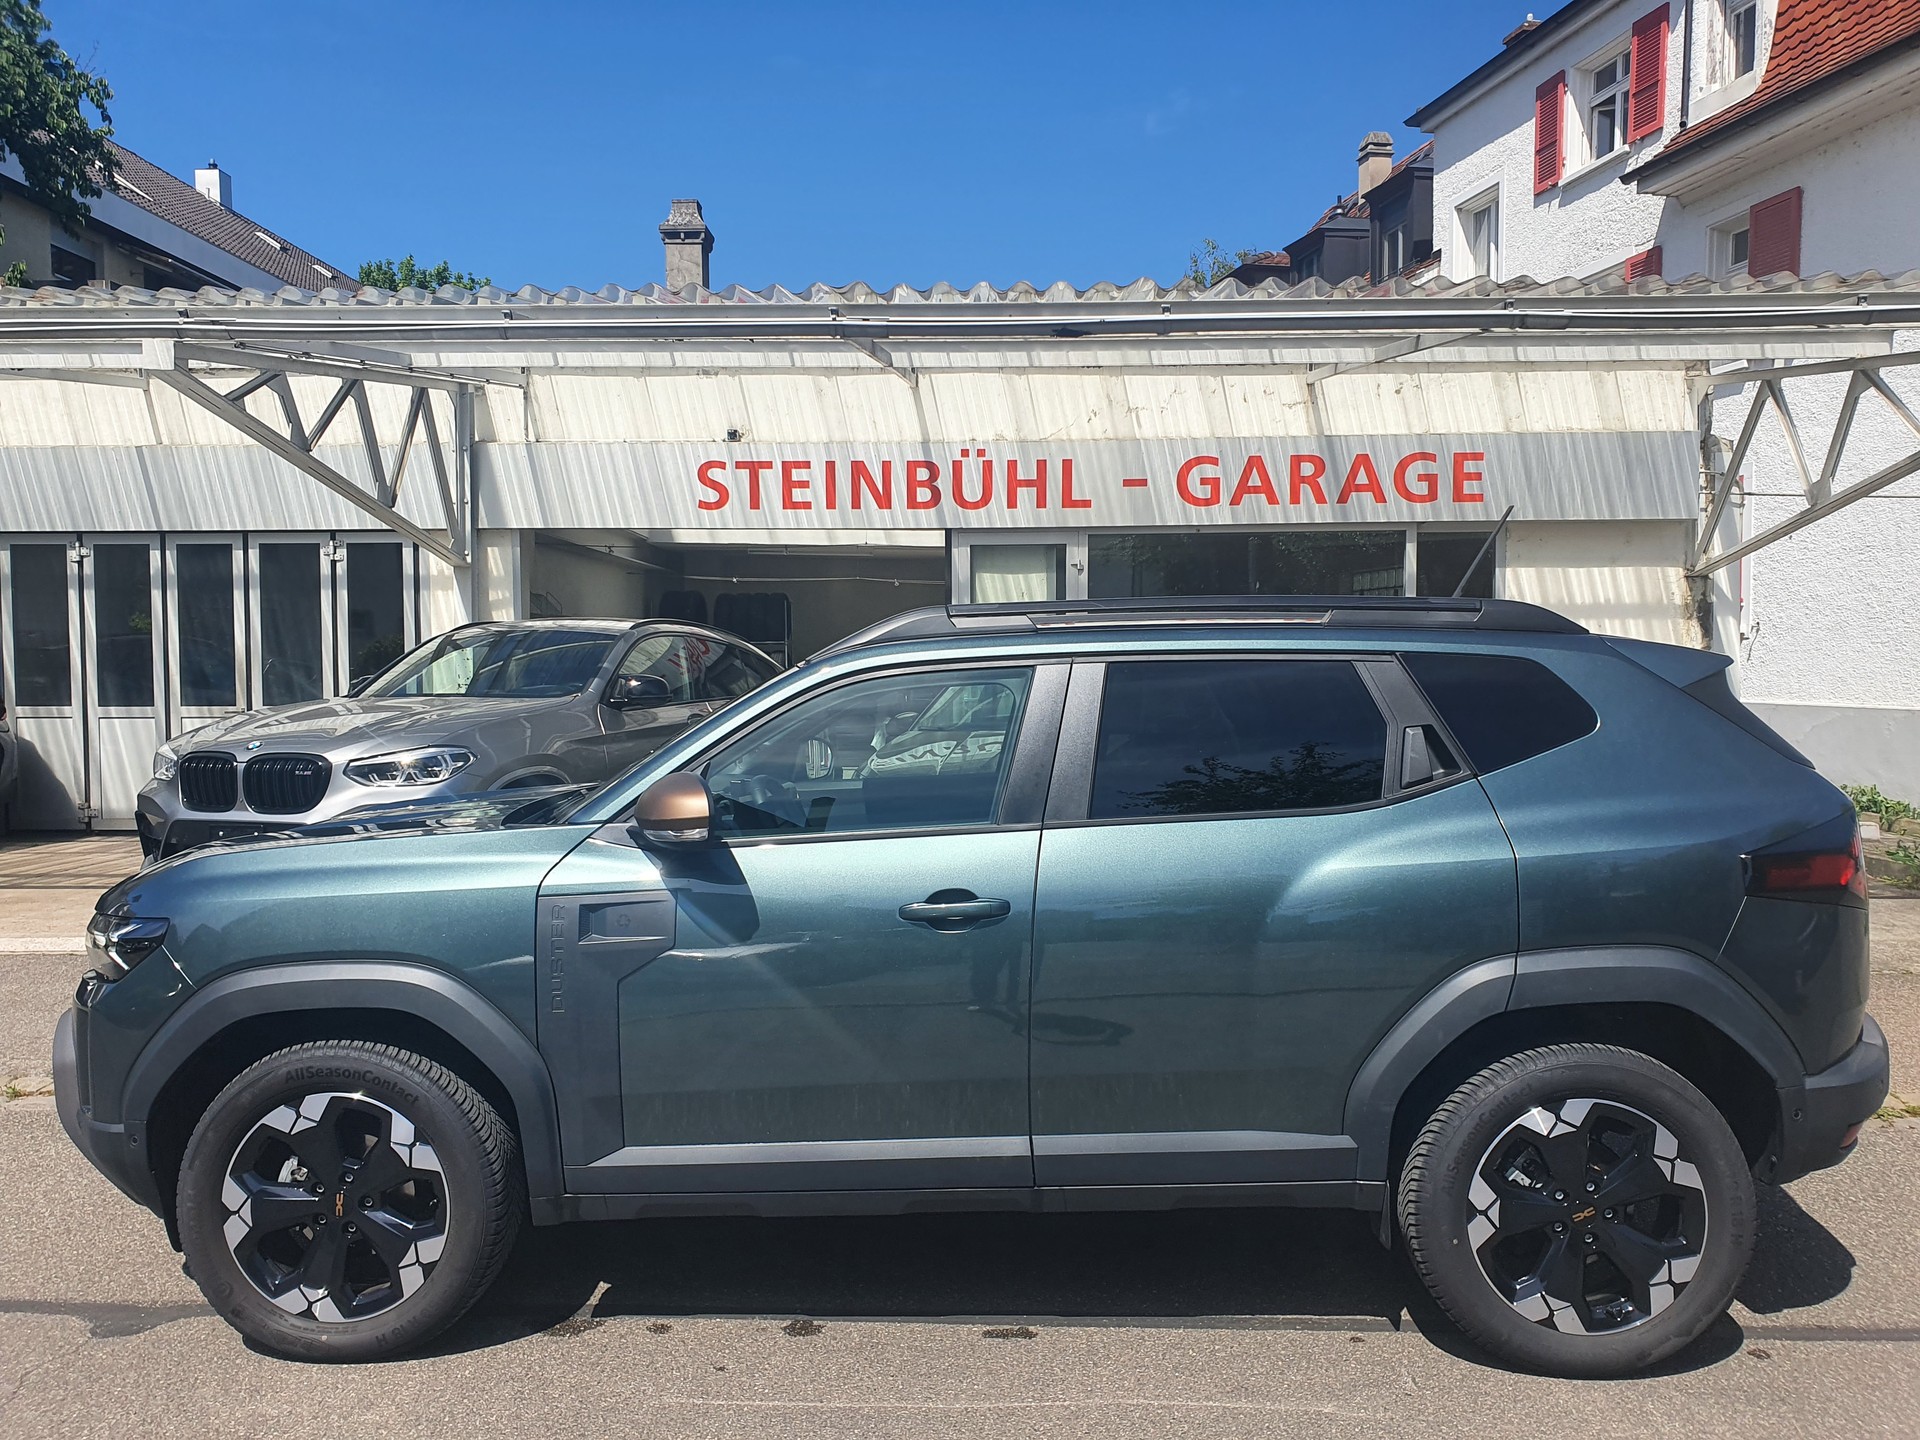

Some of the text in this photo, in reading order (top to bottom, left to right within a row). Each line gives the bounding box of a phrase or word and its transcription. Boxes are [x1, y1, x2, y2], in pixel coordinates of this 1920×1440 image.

[697, 448, 1485, 511] STEINBÜHL - GARAGE
[551, 904, 566, 1013] DUSTER
[284, 1065, 421, 1106] AllSeasonContact
